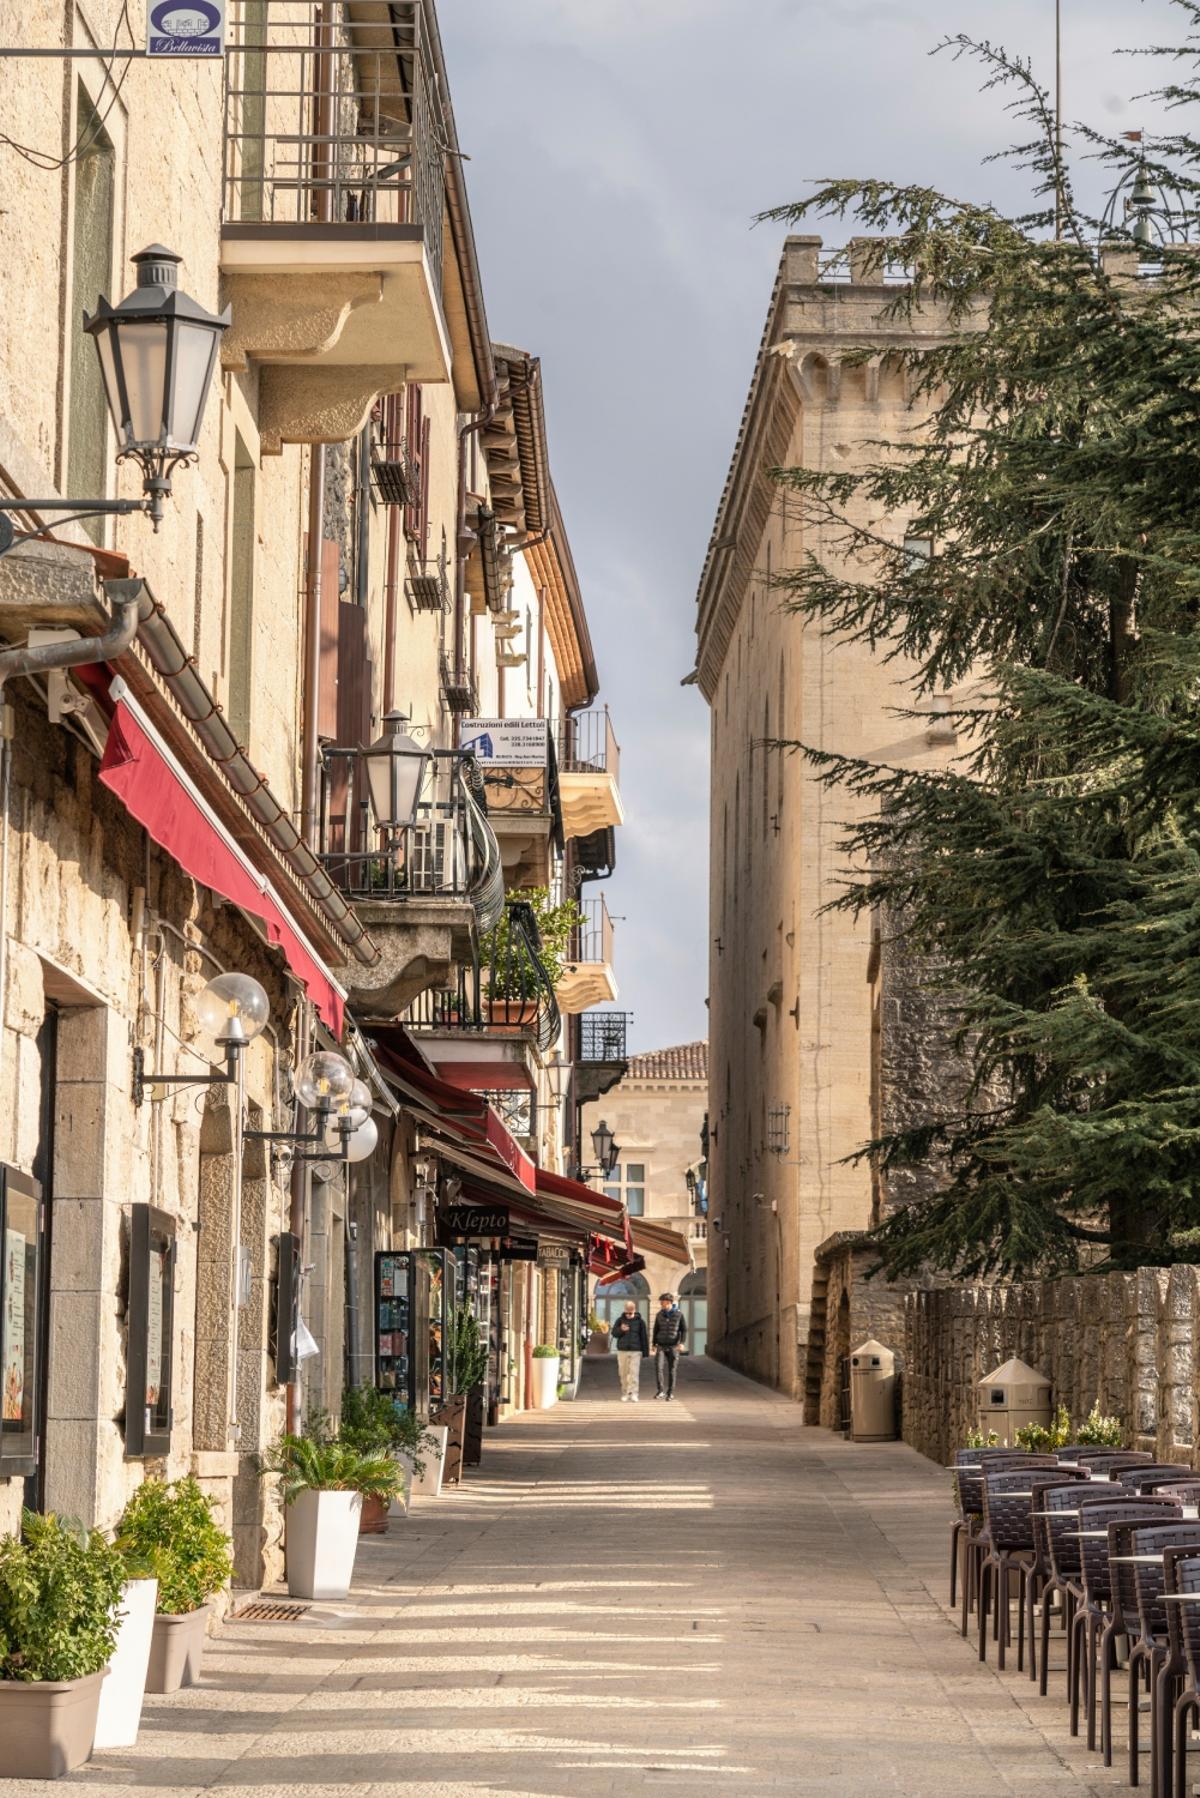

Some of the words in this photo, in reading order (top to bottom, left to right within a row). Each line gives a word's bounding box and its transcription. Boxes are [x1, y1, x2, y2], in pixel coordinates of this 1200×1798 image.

[155, 38, 216, 52] Bellavista
[451, 1209, 506, 1233] Klepto
[538, 1247, 568, 1258] TABACC
